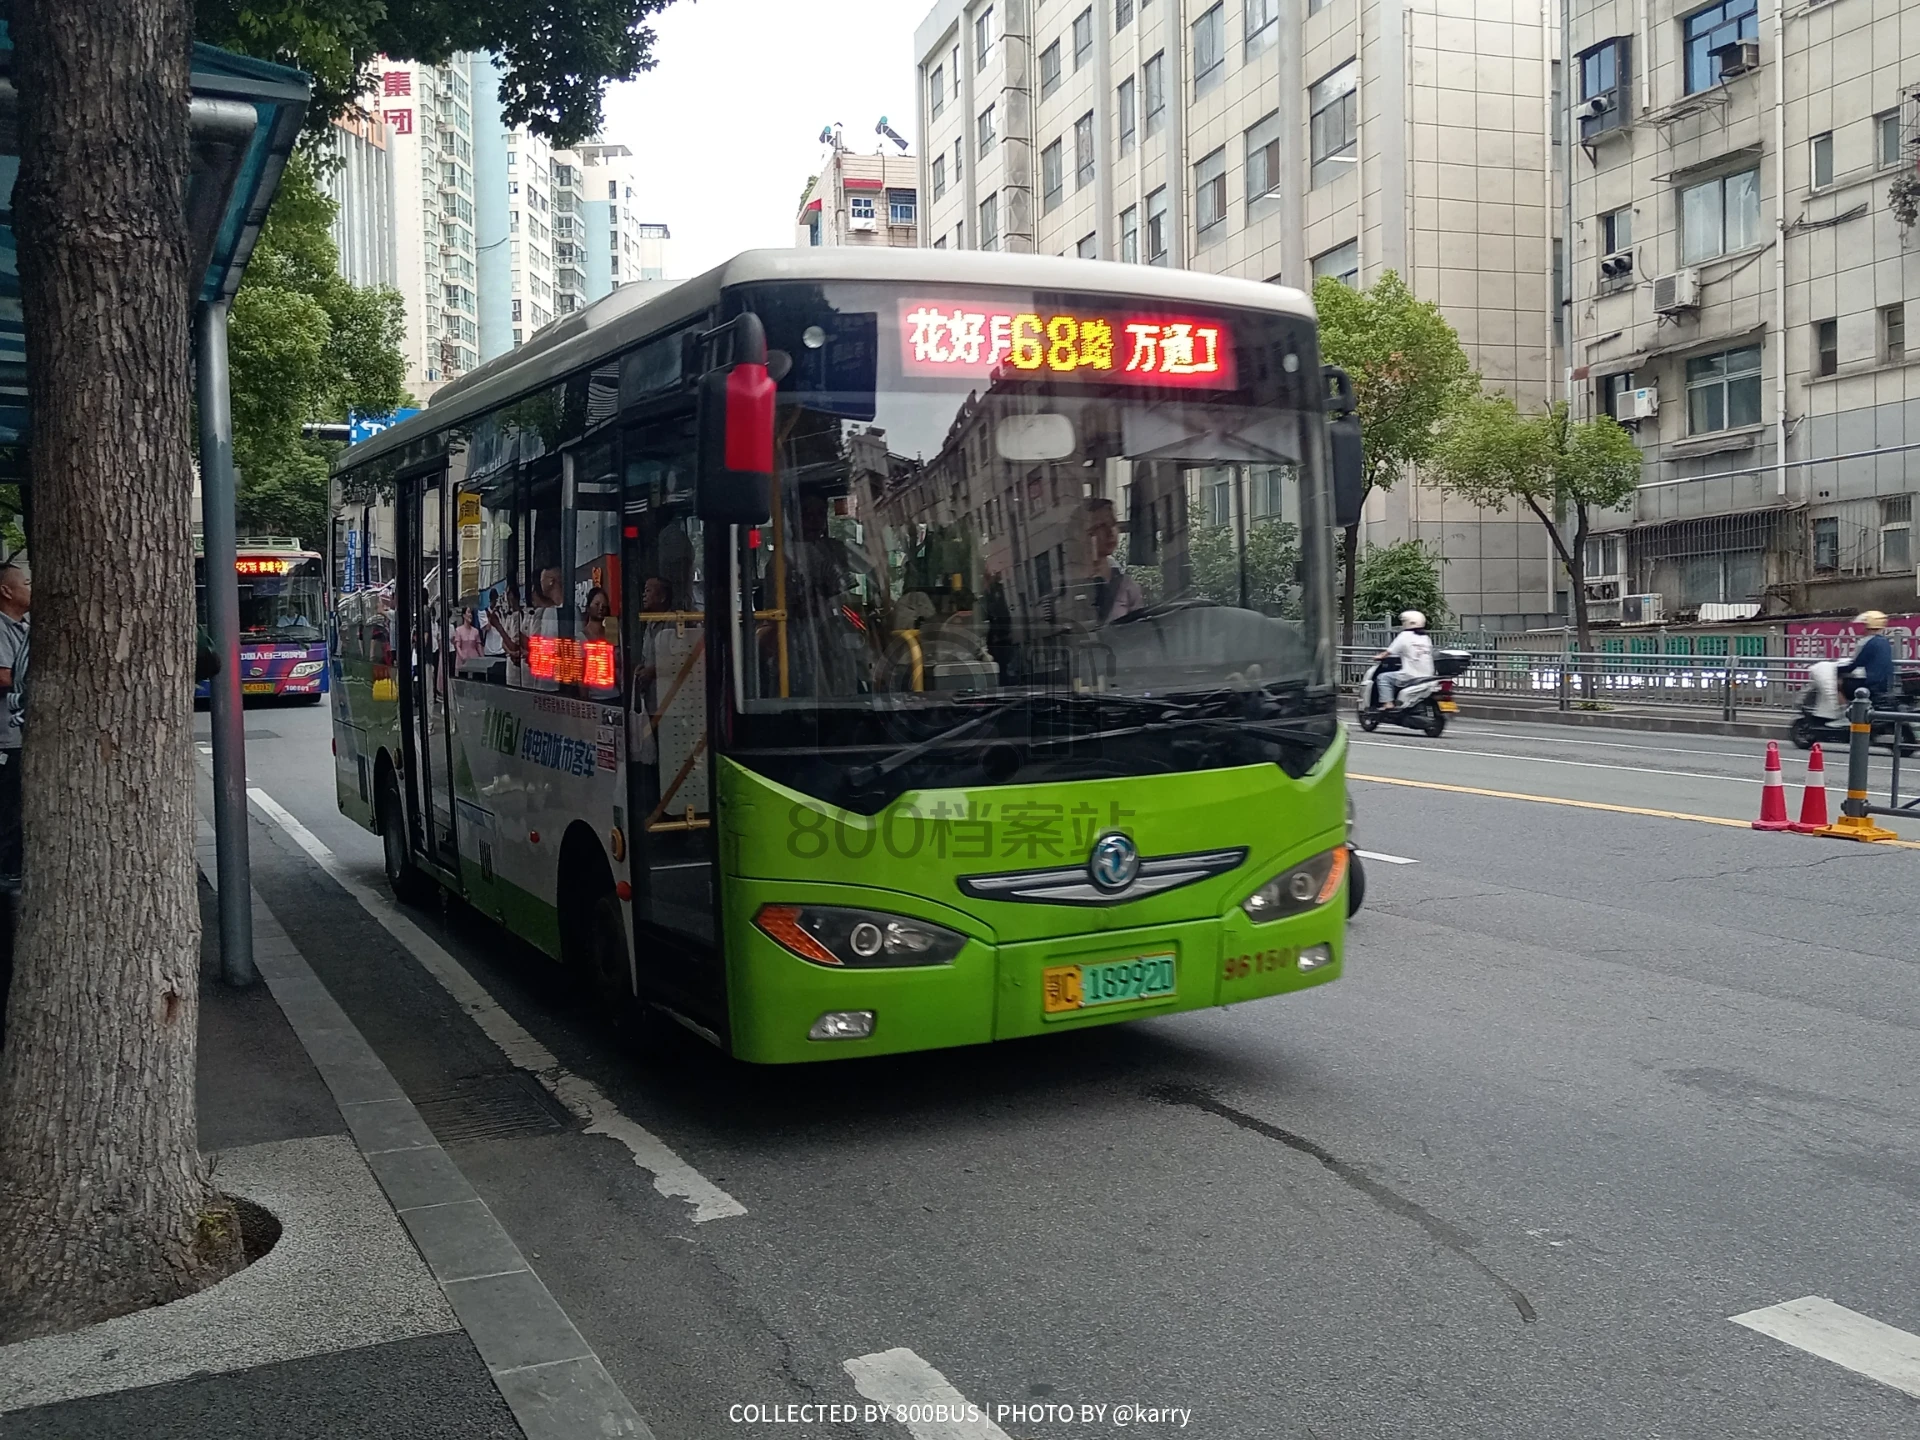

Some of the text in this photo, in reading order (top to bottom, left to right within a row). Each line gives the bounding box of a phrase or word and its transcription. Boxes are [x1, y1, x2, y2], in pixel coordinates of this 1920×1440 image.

[1011, 313, 1114, 372] 68路
[521, 727, 597, 778] 纯电动城市客车
